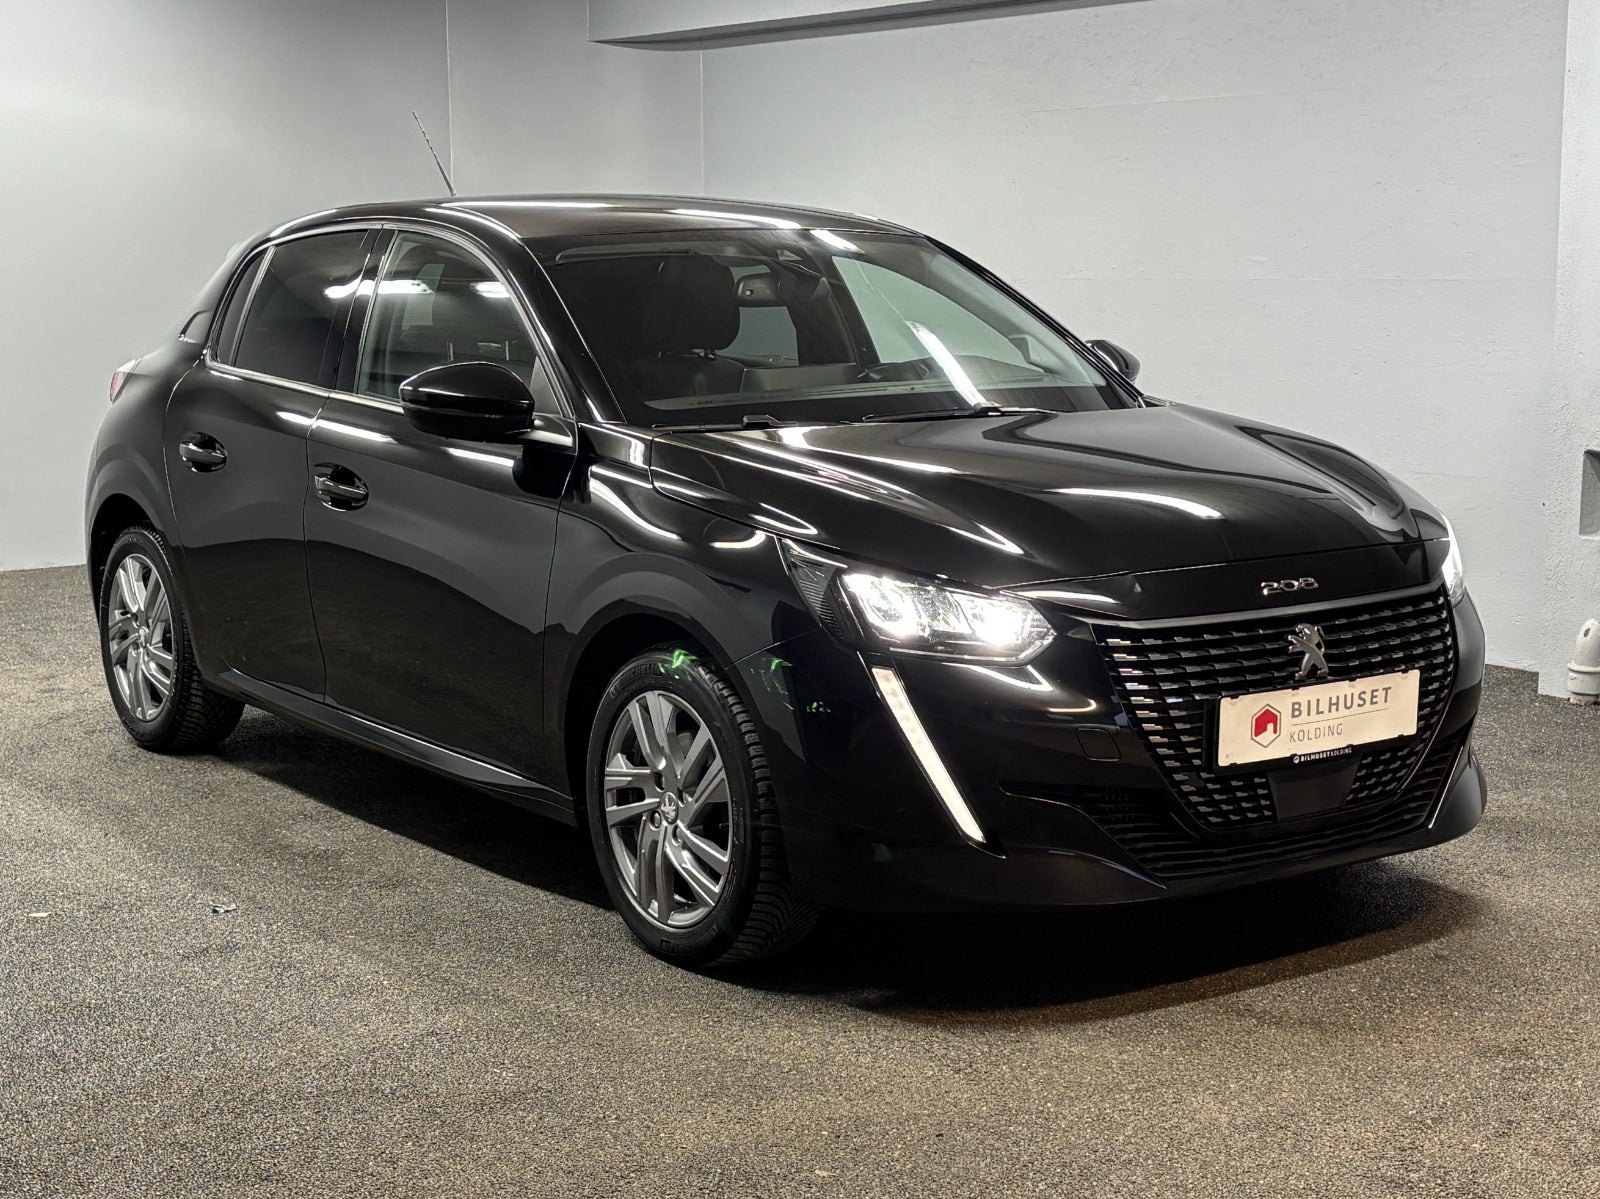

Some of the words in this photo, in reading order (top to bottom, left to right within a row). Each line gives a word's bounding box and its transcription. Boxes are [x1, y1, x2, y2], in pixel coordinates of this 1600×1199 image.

[1260, 577, 1319, 595] 208
[1290, 686, 1392, 719] BILHUSET
[1289, 723, 1343, 743] KOLDING
